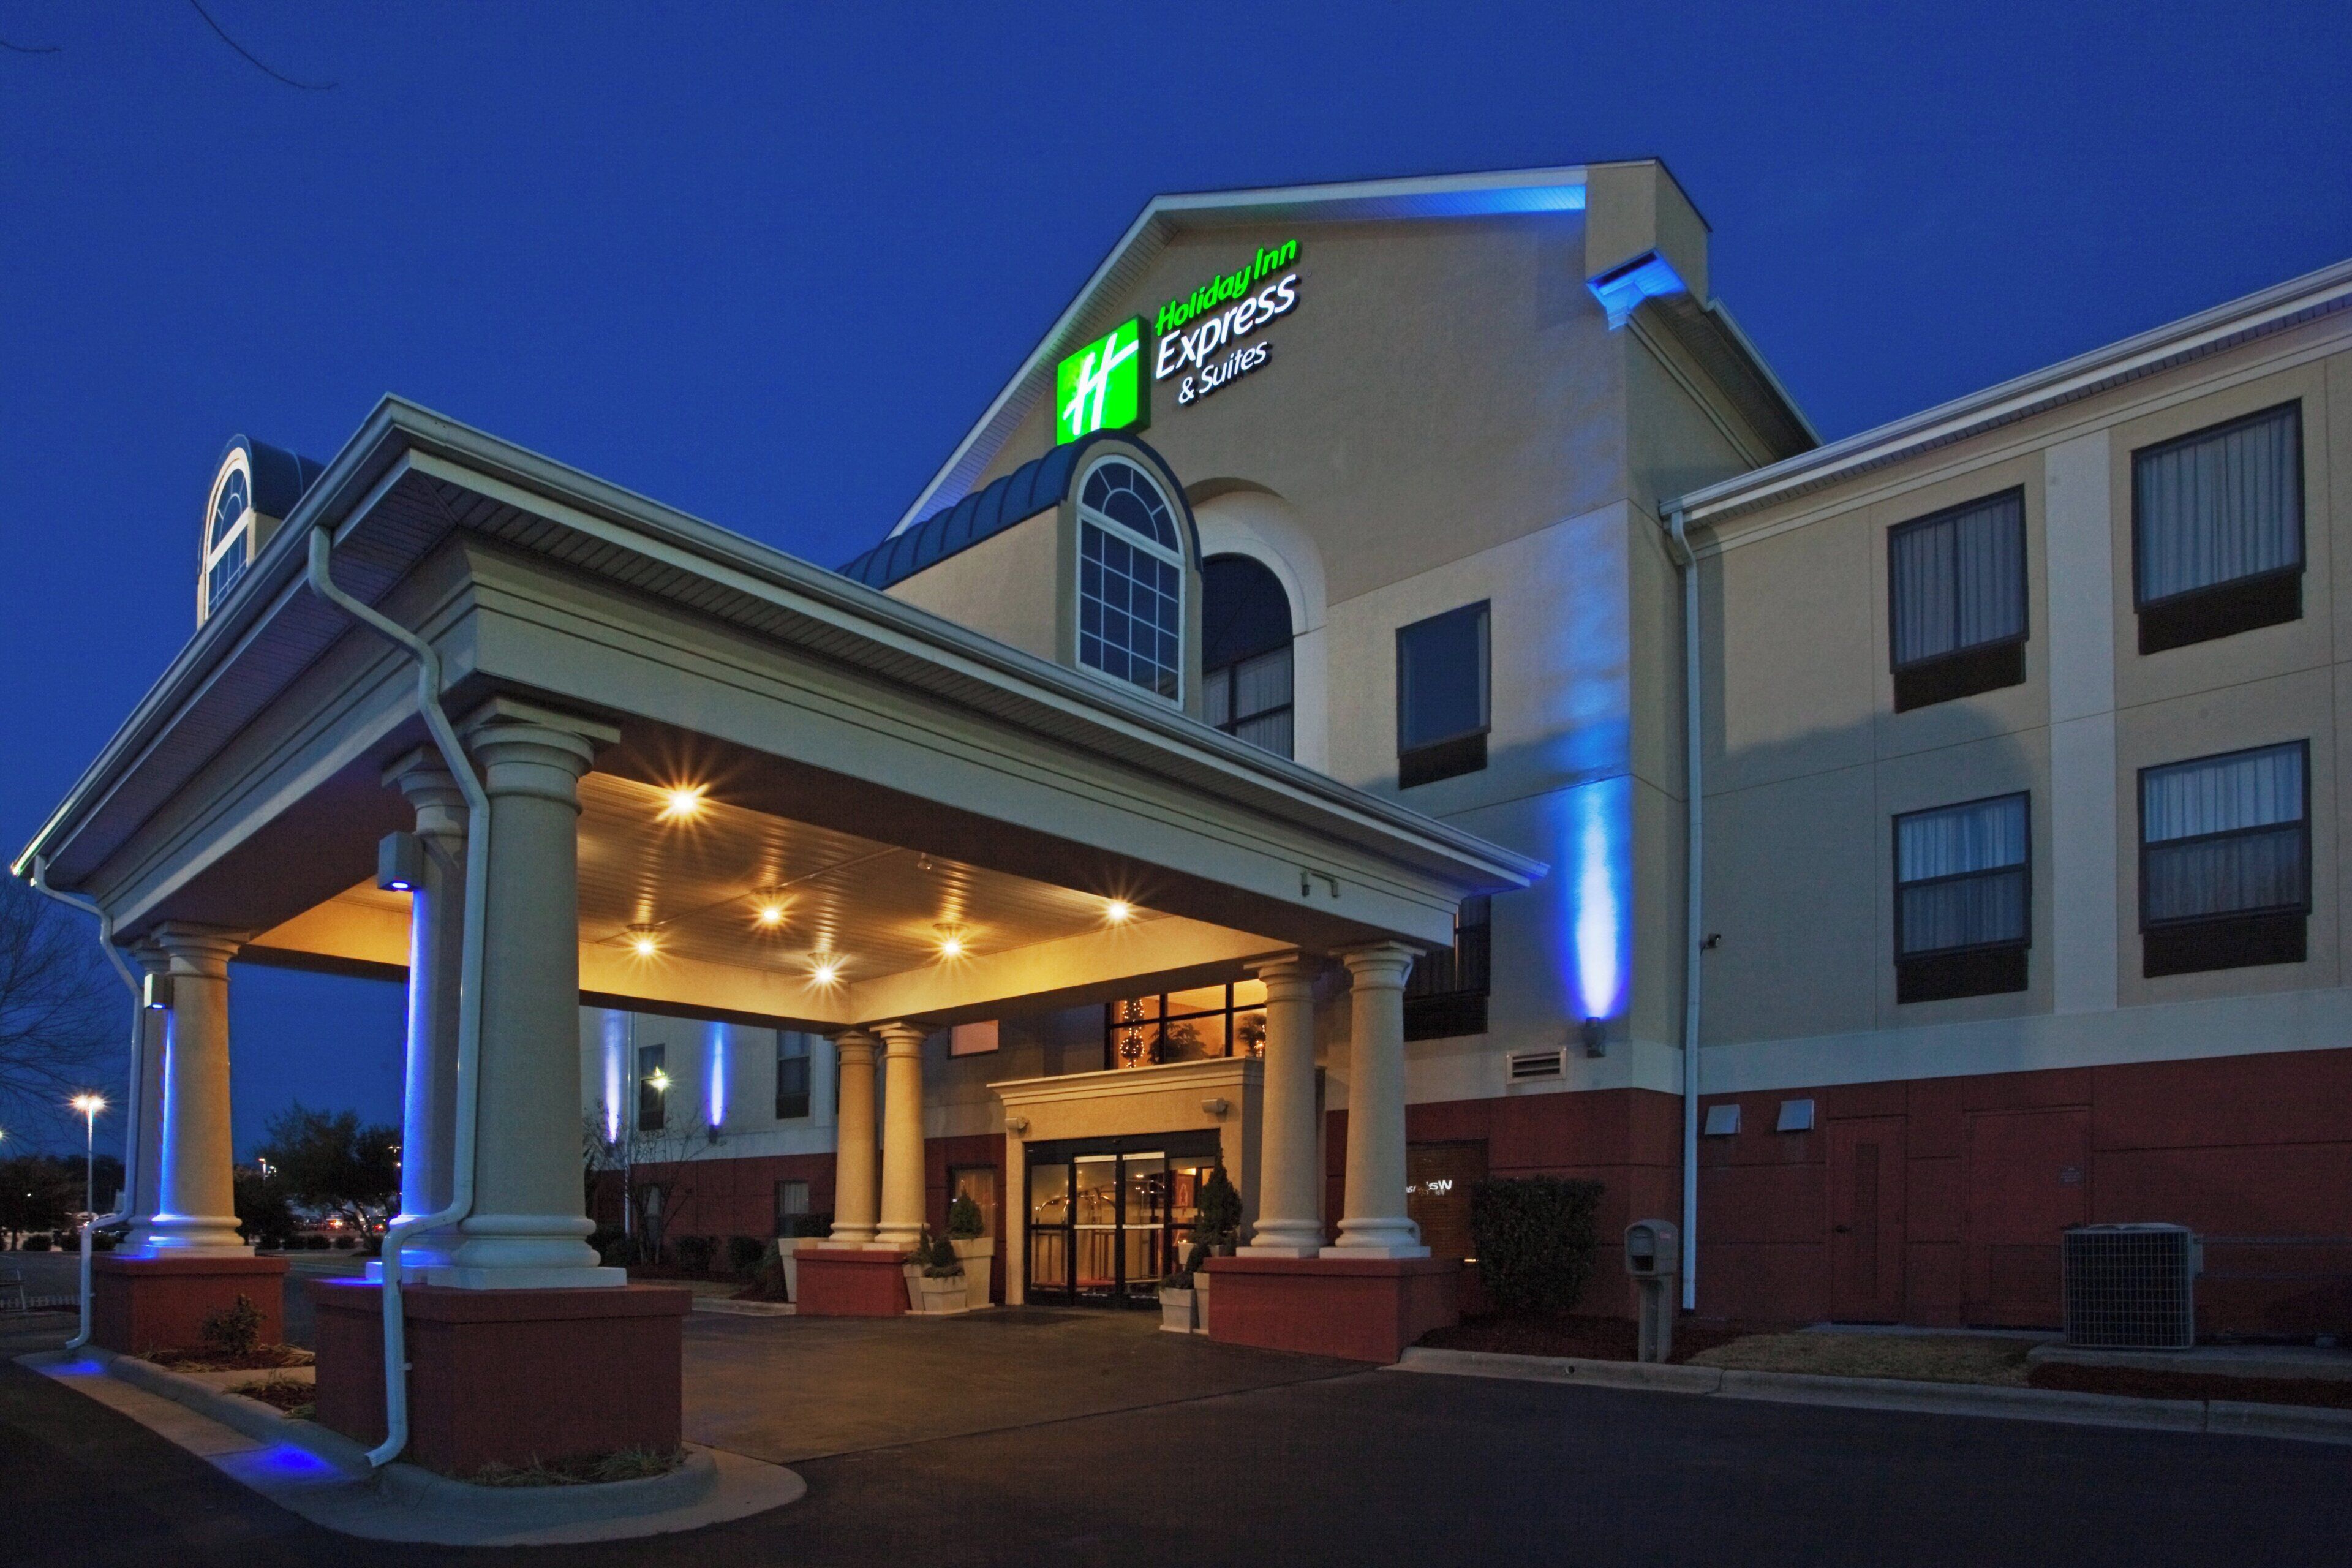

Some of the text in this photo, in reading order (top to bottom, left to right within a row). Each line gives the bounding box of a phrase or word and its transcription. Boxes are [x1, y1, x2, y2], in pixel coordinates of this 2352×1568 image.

[1155, 239, 1297, 336] Holiday Inn
[1156, 274, 1296, 379] Express
[1178, 341, 1267, 404] & Suites
